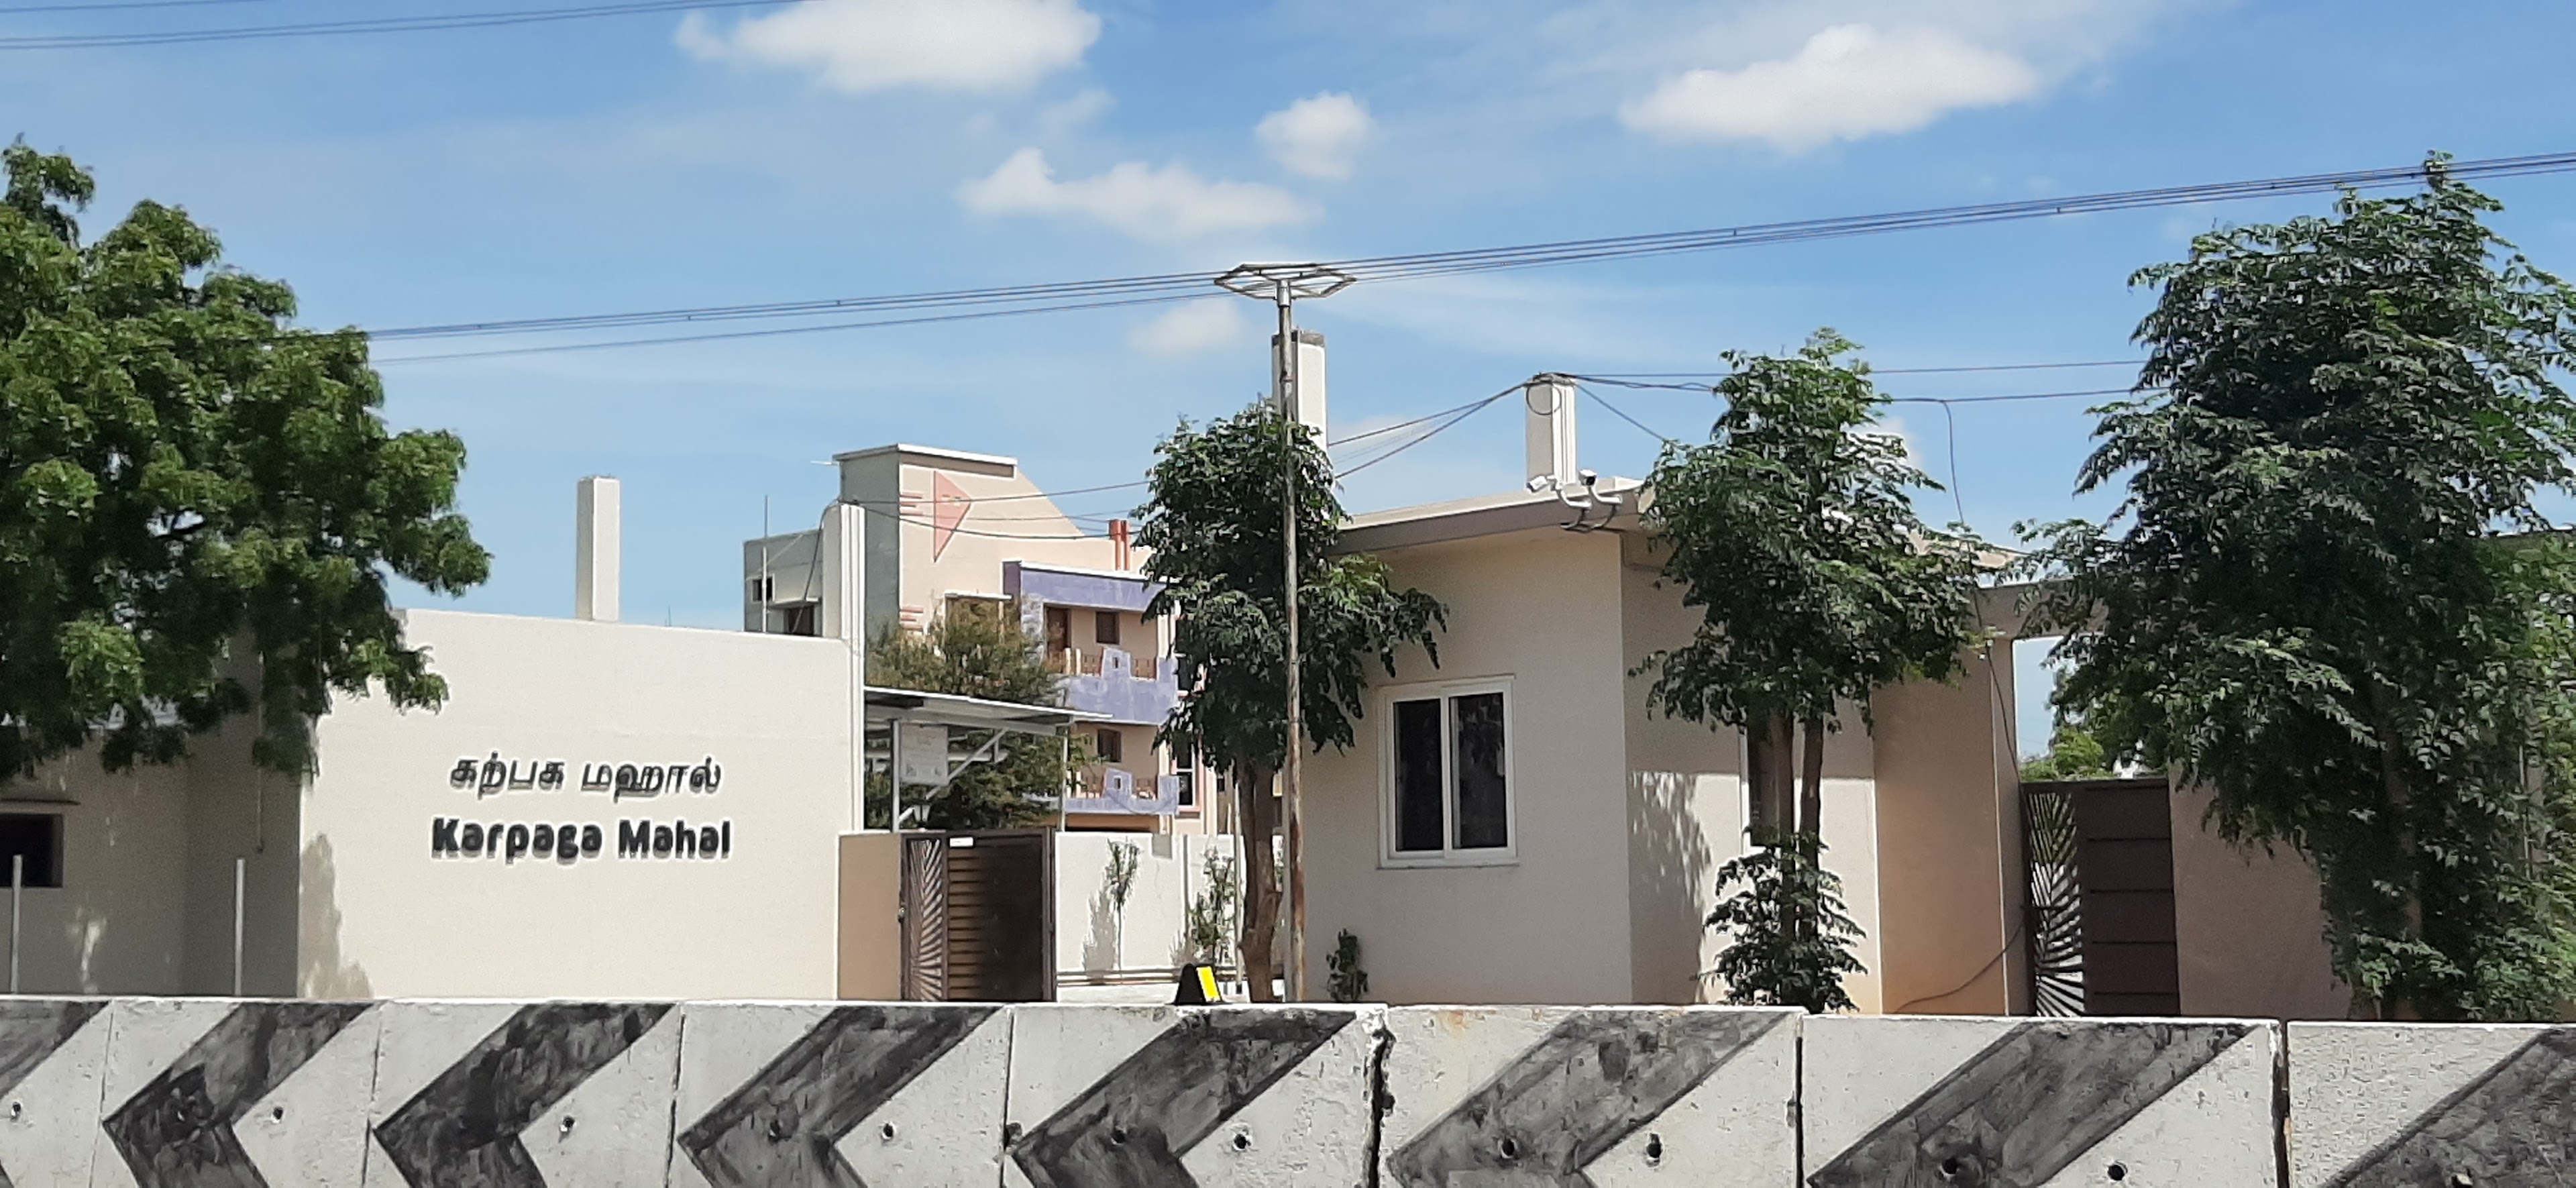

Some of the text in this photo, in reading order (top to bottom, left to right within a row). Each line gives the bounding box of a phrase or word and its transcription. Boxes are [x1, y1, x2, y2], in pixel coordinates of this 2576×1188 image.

[450, 751, 722, 803] கற்பக மஹால்
[431, 817, 731, 865] Karpaga Mahal
